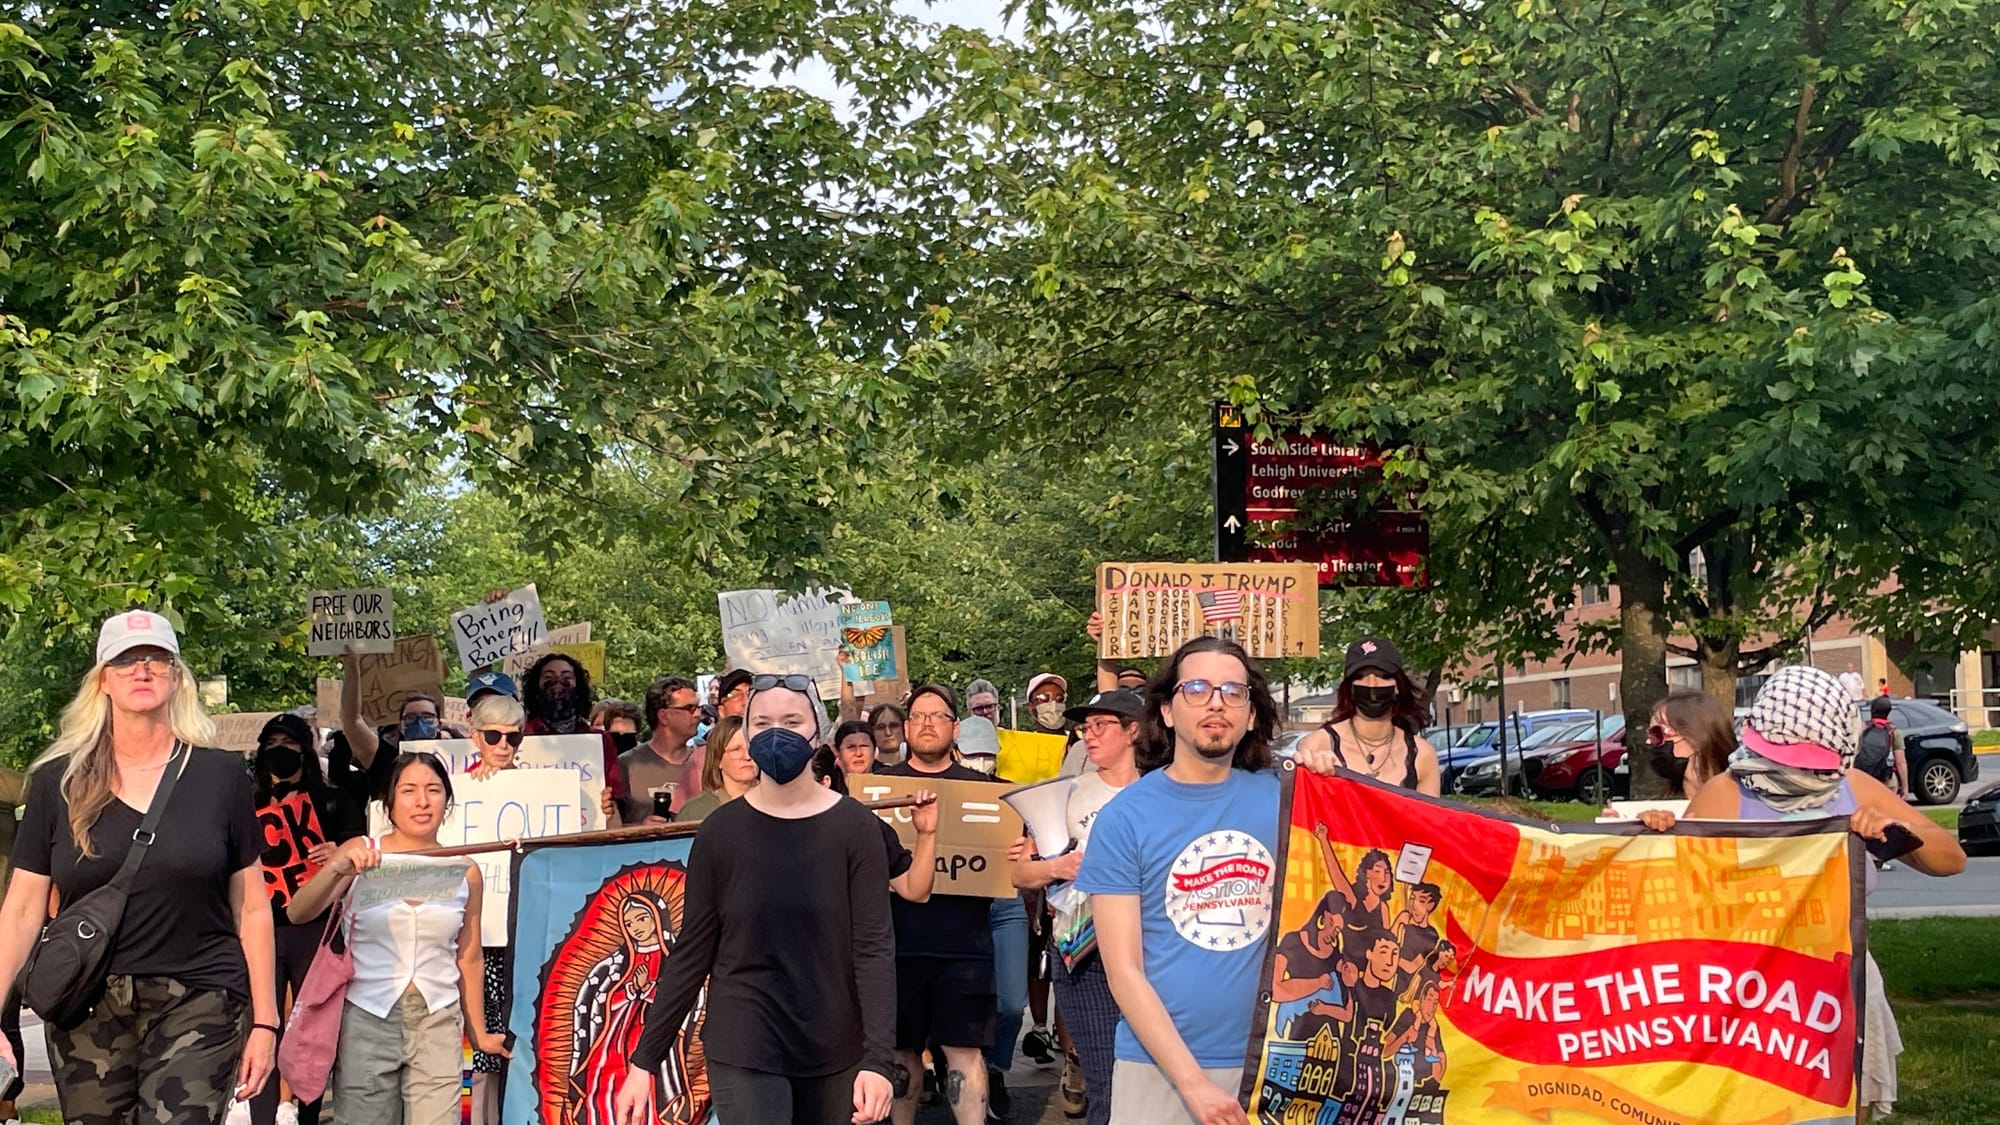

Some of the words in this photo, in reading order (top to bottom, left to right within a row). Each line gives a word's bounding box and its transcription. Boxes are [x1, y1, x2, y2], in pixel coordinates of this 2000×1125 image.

[1321, 443, 1368, 460] Library
[1251, 463, 1296, 480] Lehigh
[1299, 464, 1365, 478] Universit
[1105, 566, 1192, 590] DONALD
[1200, 573, 1216, 589] J.
[1222, 572, 1297, 595] TRUMP
[312, 595, 347, 616] FREE
[353, 594, 383, 615] OUR
[312, 620, 391, 642] NEIGHBORS
[457, 603, 524, 639] Bring
[472, 625, 522, 650] Them
[1183, 873, 1214, 888] MAKE
[1213, 864, 1235, 879] THE
[1235, 863, 1266, 878] ROAD
[1182, 897, 1262, 911] PENNSYLVANIA
[1186, 879, 1261, 905] ACTION
[1462, 964, 1581, 1023] MAKE
[1585, 963, 1684, 1016] THE
[1699, 964, 1842, 1034] ROAD
[1557, 1014, 1831, 1080] PENNSYLVANIA
[1528, 1082, 1605, 1107] DIGNIDAD,
